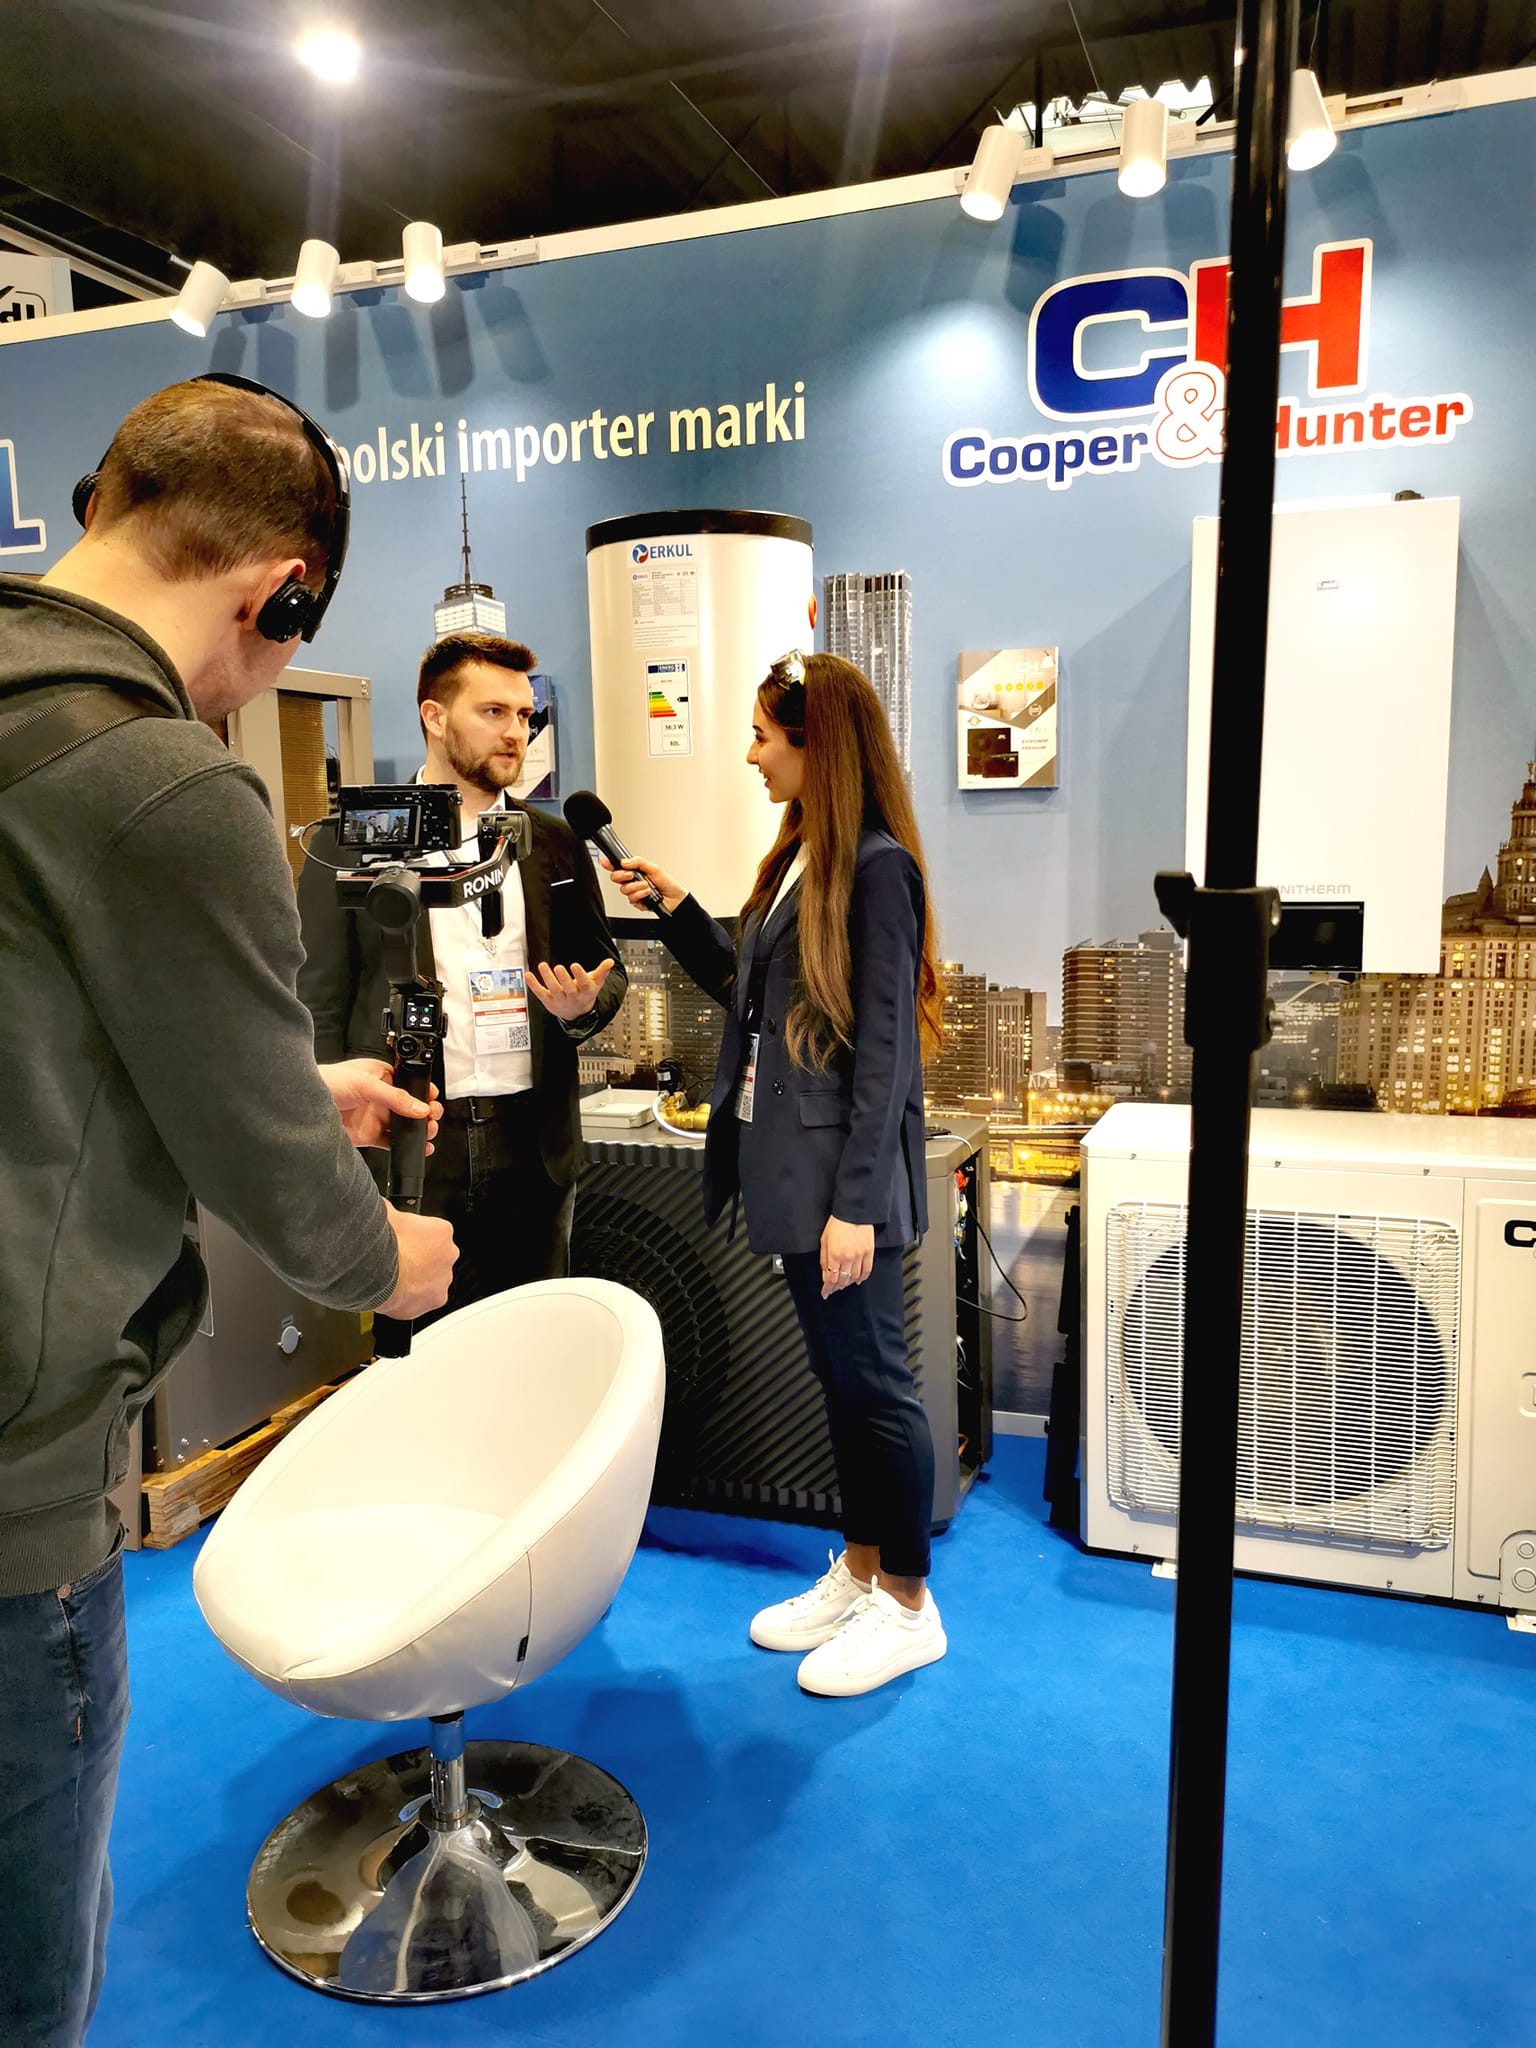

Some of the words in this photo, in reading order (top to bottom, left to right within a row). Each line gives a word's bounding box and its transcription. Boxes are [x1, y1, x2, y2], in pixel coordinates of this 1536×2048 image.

[1034, 246, 1366, 415] CH
[456, 408, 654, 483] importer
[669, 381, 806, 453] marki
[949, 432, 1148, 483] Cooper
[650, 544, 693, 559] ERKUL
[463, 866, 505, 899] RONIN
[1271, 884, 1351, 895] NITHERM
